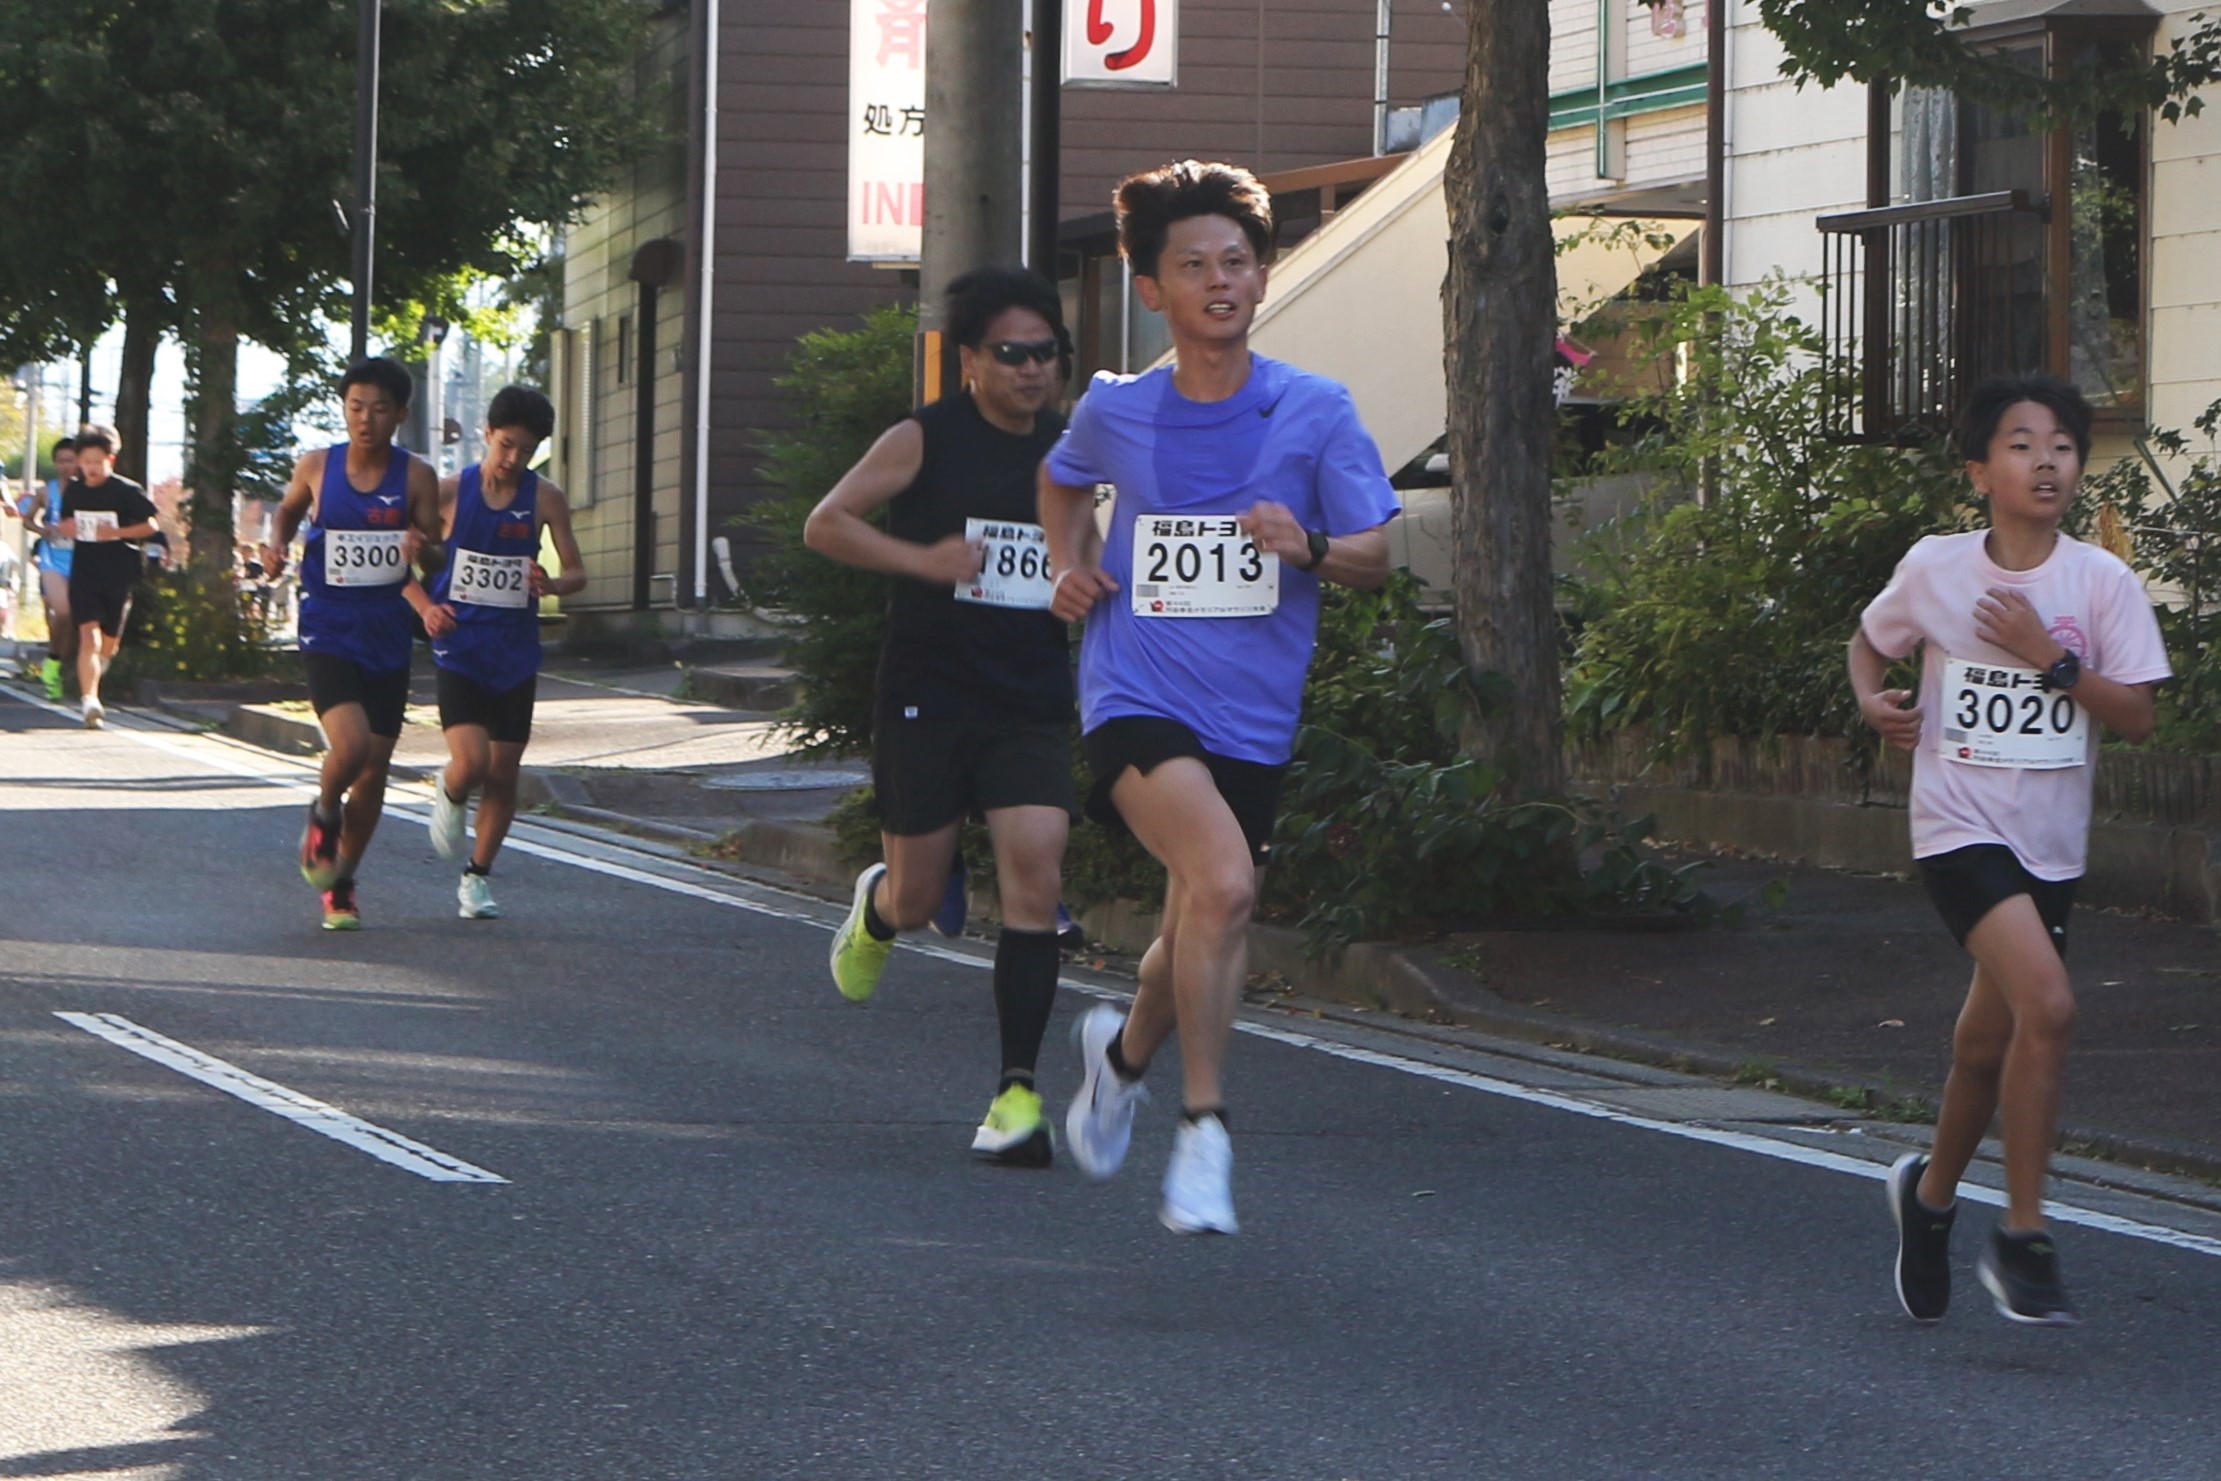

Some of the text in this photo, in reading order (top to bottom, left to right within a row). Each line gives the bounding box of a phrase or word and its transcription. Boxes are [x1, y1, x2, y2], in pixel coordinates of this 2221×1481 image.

[863, 103, 926, 136] 処方
[334, 545, 400, 567] 3300
[1147, 543, 1264, 583] 2013
[460, 564, 523, 591] 3302
[1957, 688, 2076, 735] 3020
